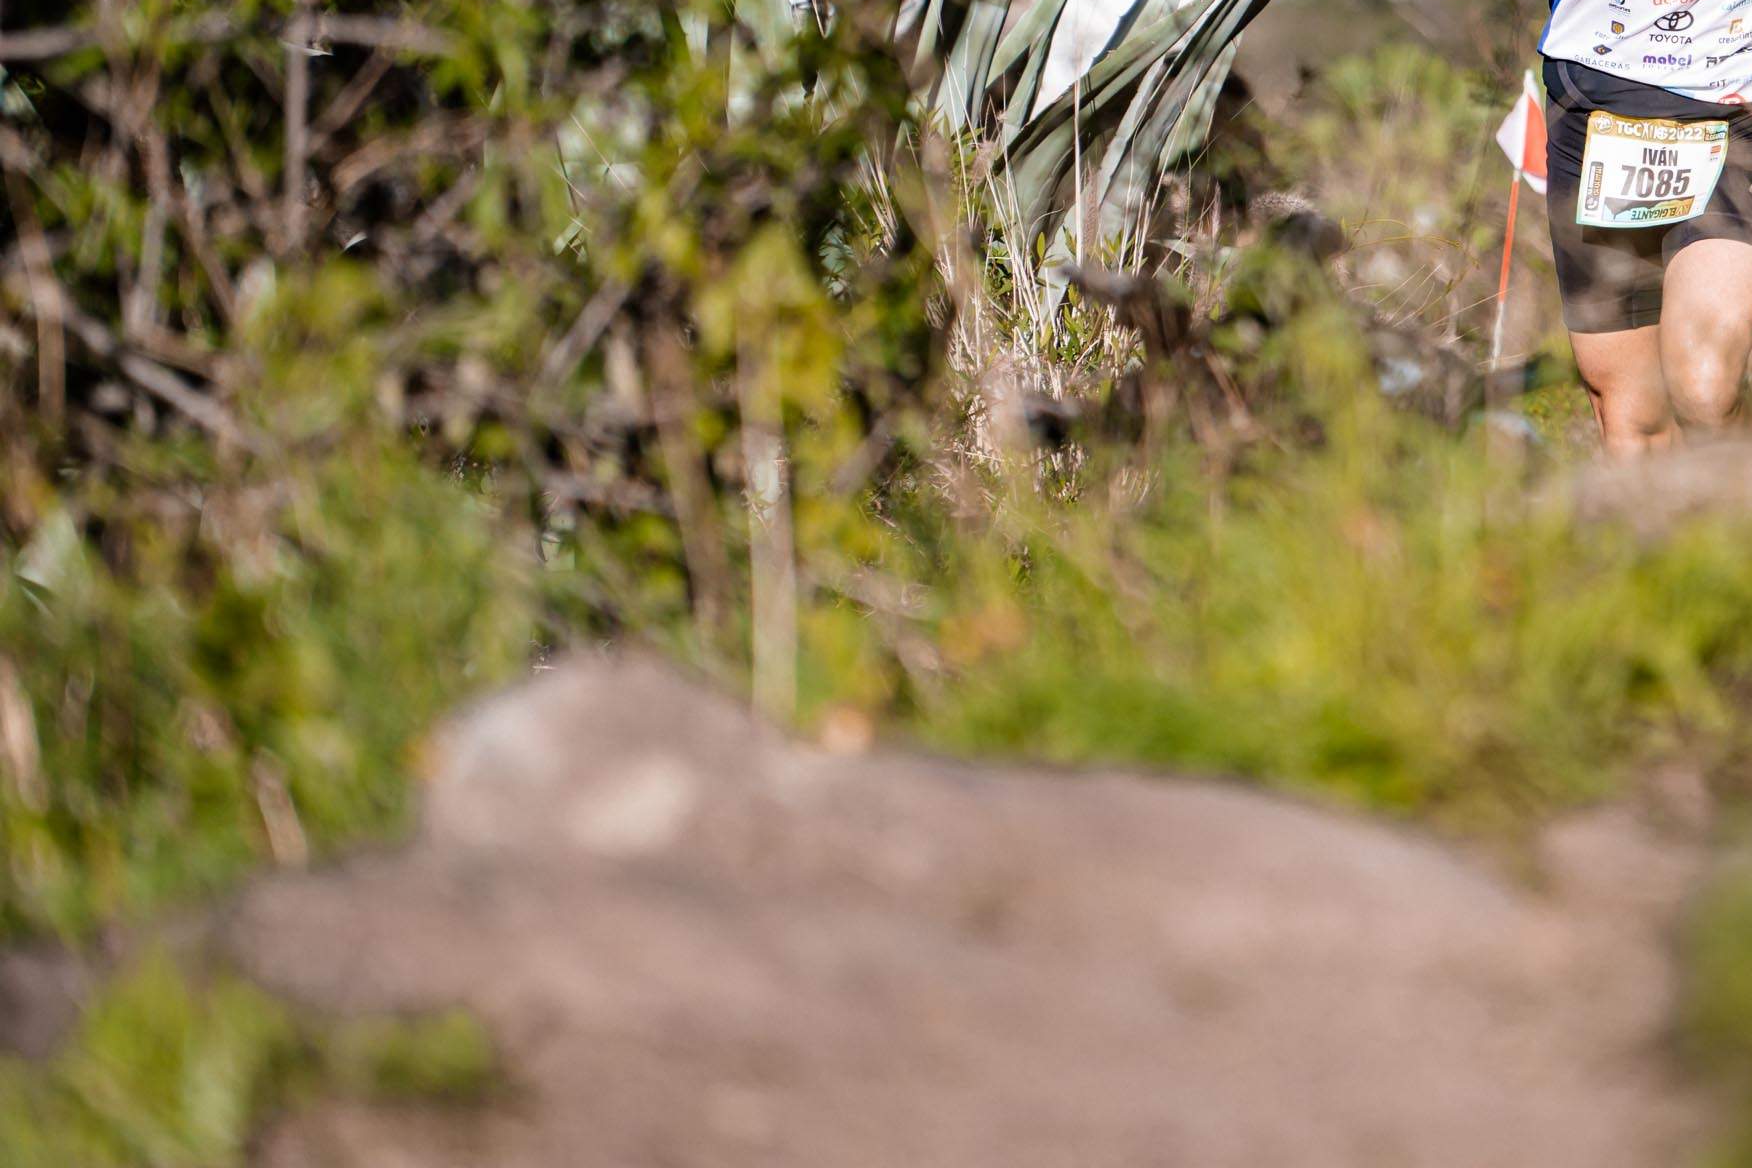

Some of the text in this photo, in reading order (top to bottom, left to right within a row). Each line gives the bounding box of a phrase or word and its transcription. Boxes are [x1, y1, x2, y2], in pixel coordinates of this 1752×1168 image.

[1649, 34, 1692, 45] TOYOTA
[1642, 146, 1678, 167] IVÁN
[1621, 165, 1692, 199] 7085
[1630, 207, 1669, 220] GIGANTE
